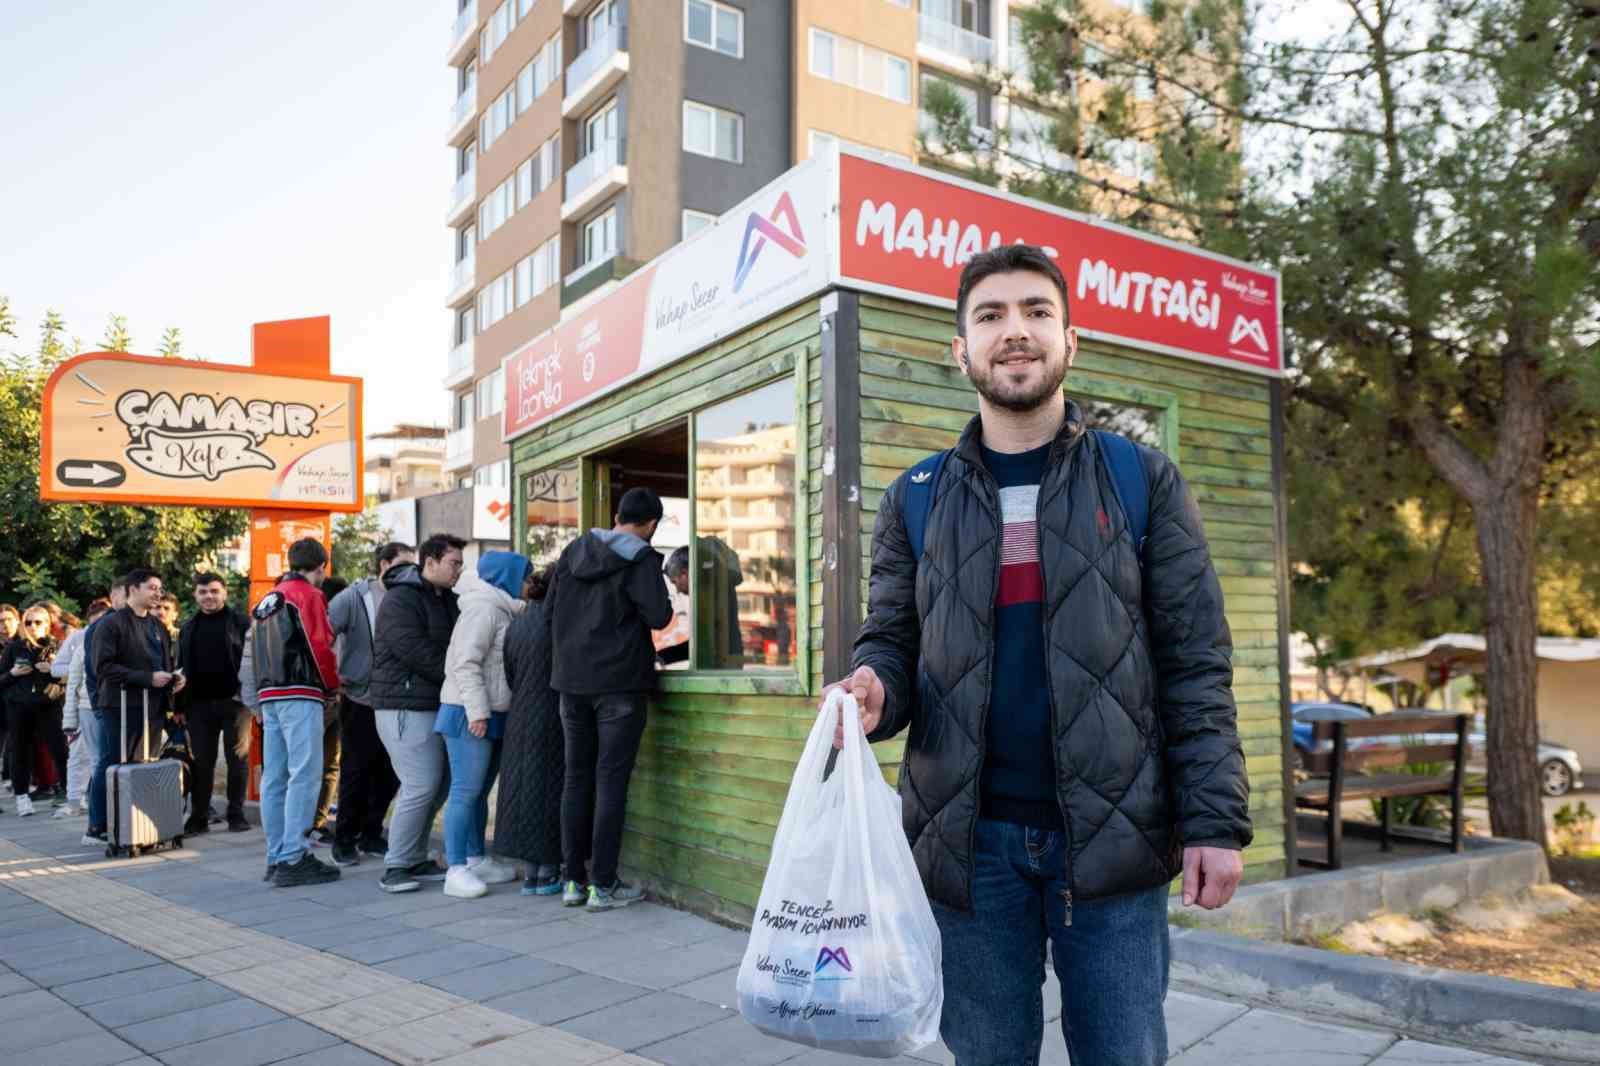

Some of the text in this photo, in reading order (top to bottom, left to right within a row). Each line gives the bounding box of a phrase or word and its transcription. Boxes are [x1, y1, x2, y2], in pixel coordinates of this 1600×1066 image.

[856, 198, 1220, 330] MAHA MUTFAĞI
[115, 389, 318, 446] ÇAMAŞIR
[165, 441, 229, 475] Kafe
